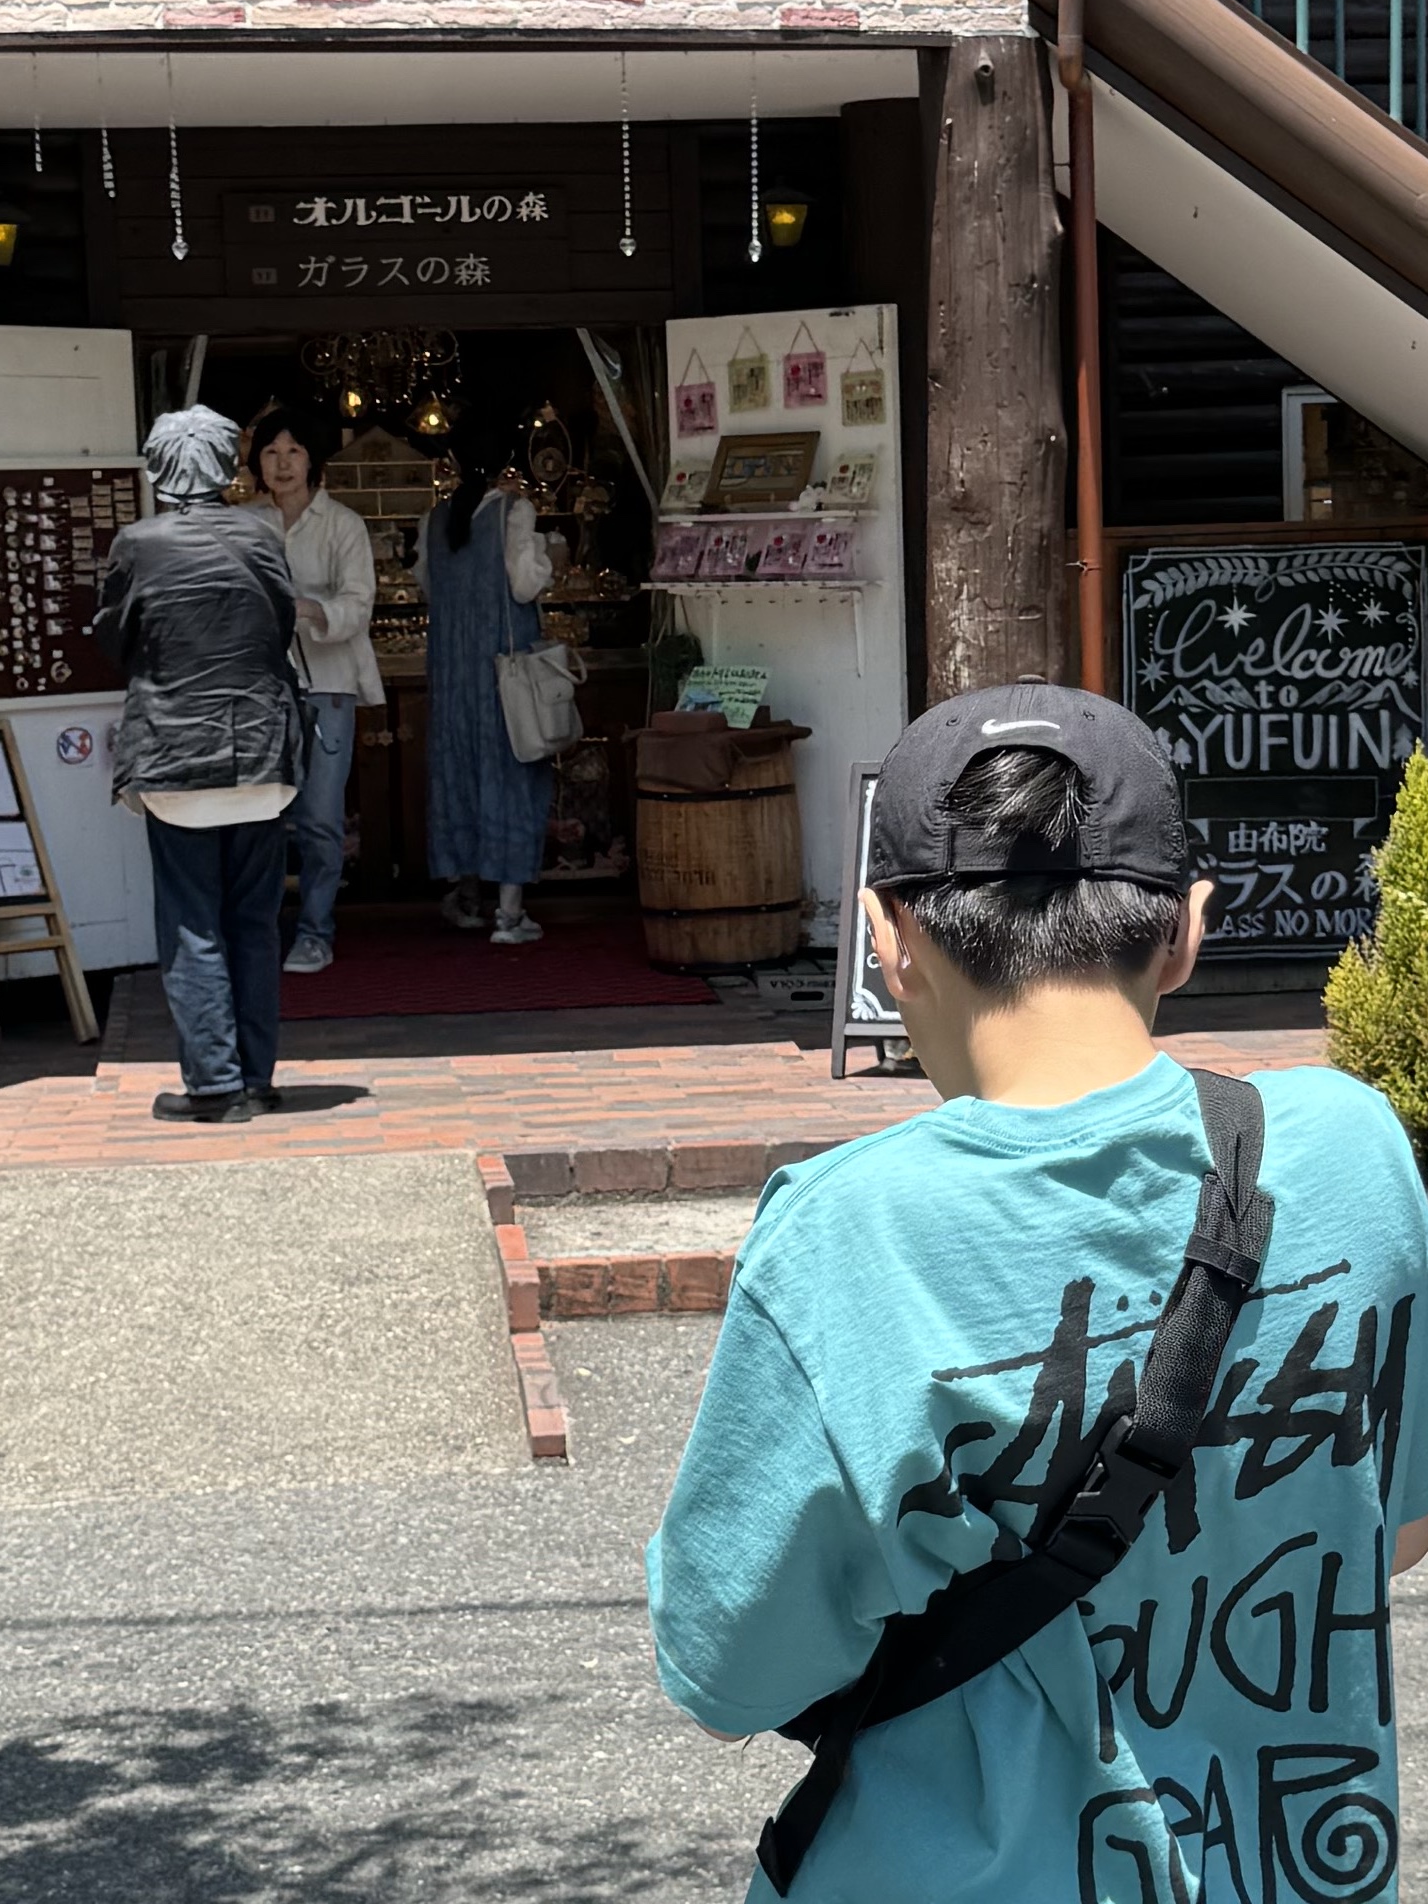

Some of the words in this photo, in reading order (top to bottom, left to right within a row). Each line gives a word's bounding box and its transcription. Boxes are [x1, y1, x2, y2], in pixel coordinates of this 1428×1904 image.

[292, 191, 550, 227] オルゴールの森
[296, 252, 493, 289] ガラスの森
[1254, 680, 1300, 709] to
[1178, 709, 1392, 775] YUFUIN
[1228, 820, 1330, 857] 由布院
[1274, 908, 1311, 937] NO
[1314, 907, 1375, 939] MOR
